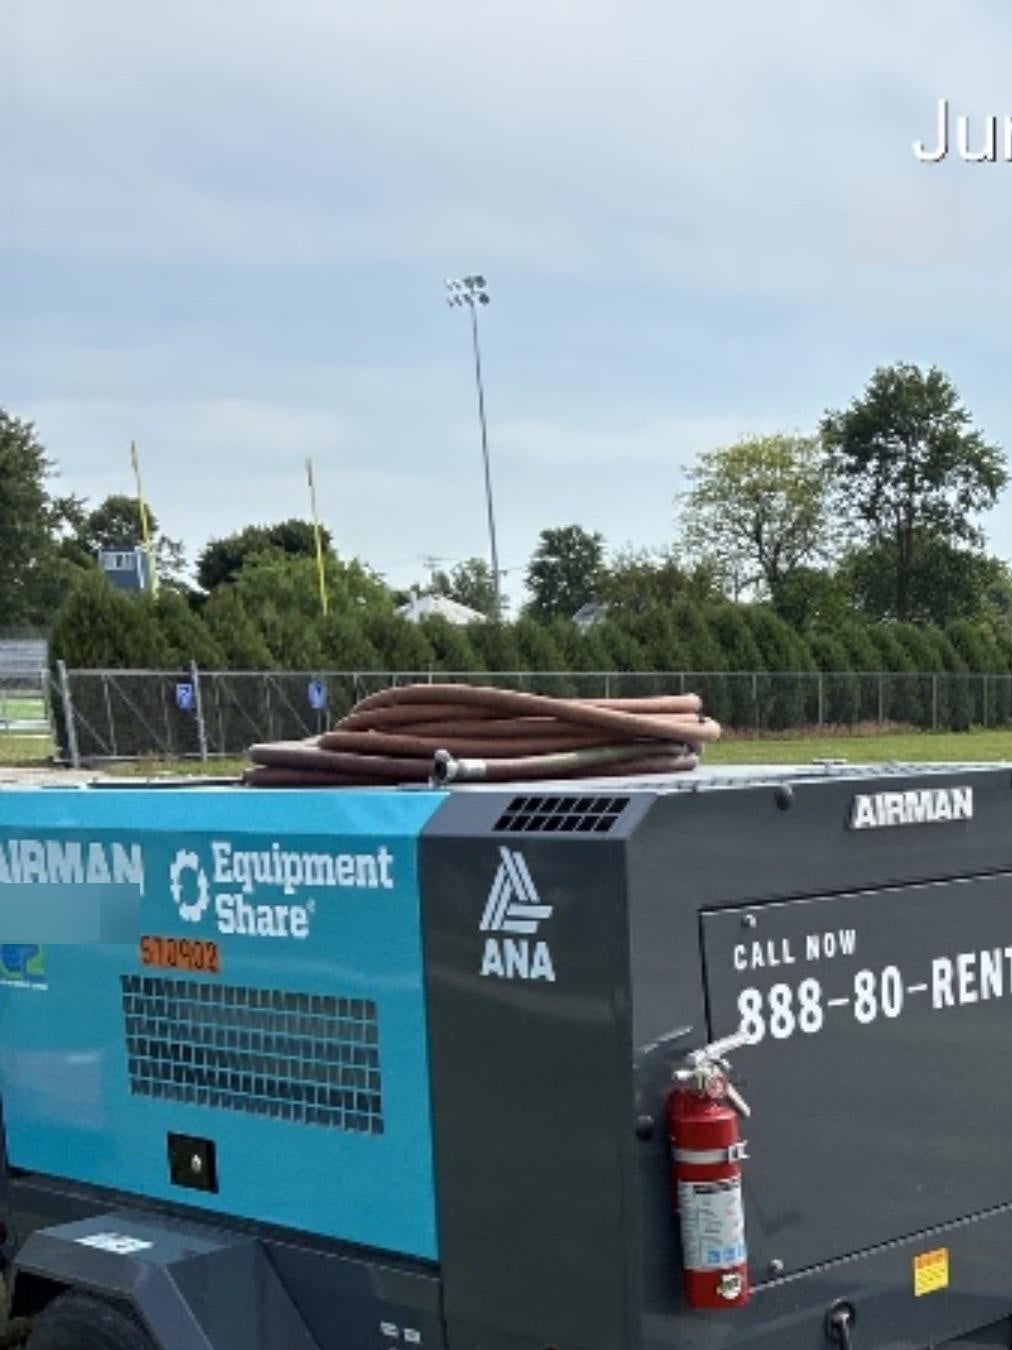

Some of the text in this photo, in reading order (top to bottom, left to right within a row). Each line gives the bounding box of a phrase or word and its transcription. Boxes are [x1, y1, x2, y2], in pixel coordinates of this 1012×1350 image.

[853, 785, 973, 829] AIRMAN
[211, 841, 395, 896] Equipment
[479, 937, 557, 982] ANA
[733, 929, 857, 971] CALL NOW
